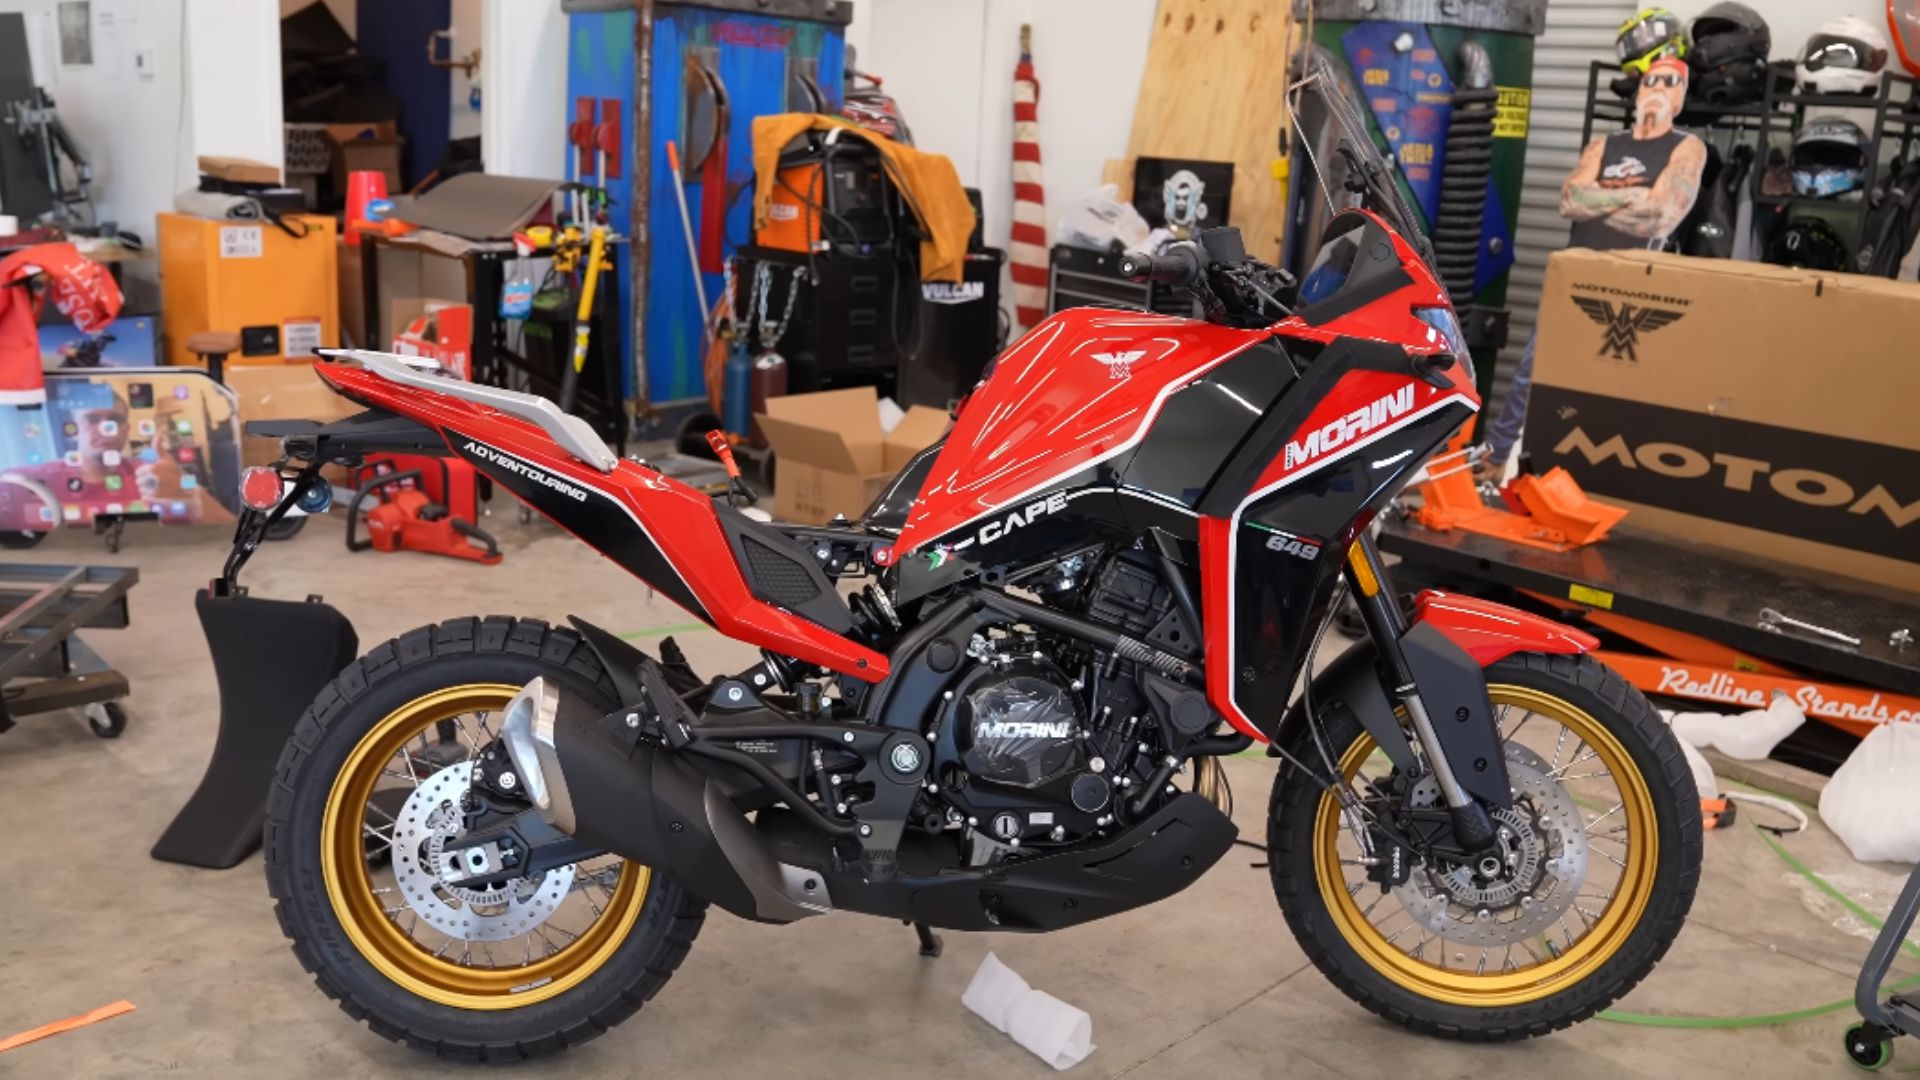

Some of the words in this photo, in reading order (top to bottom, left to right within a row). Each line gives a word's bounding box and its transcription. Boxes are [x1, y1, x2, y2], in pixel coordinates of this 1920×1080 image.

[921, 281, 984, 300] VULCAN
[1291, 383, 1415, 466] MORINI
[463, 442, 587, 502] ADVENTOURING
[978, 491, 1067, 545] CAPE
[1266, 535, 1320, 560] 649
[1657, 665, 1766, 706] Redline
[977, 721, 1070, 738] MORINI
[300, 866, 350, 963] PIRELLI
